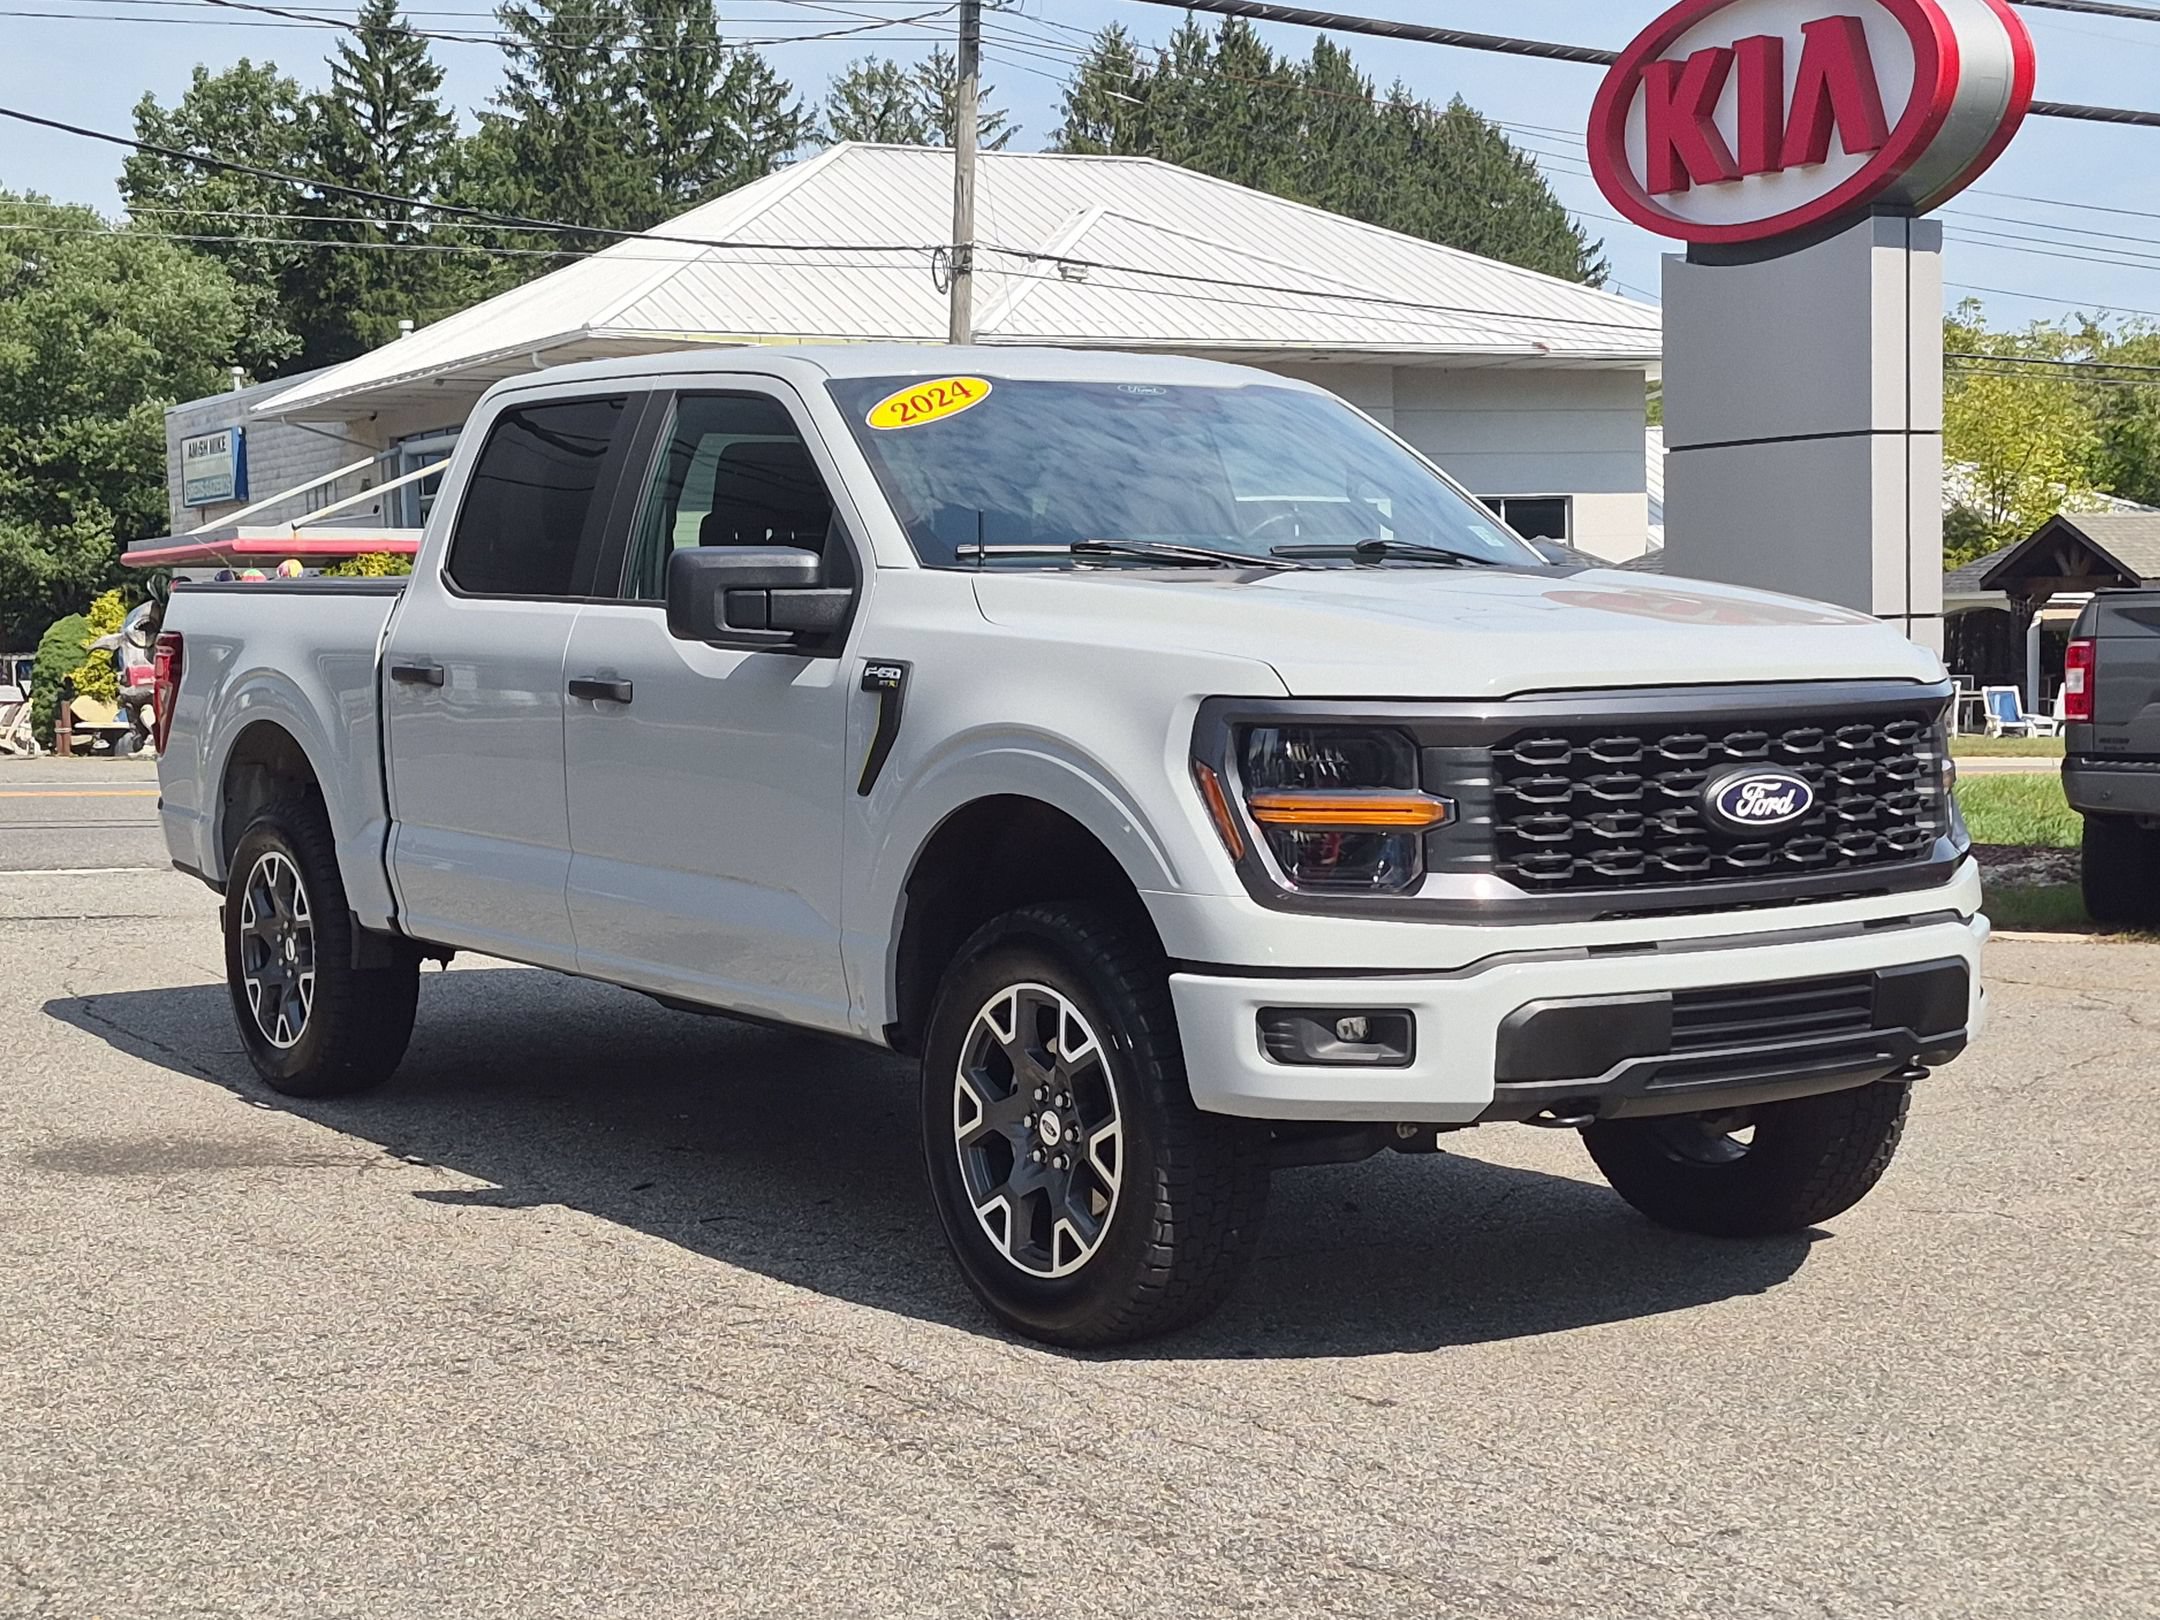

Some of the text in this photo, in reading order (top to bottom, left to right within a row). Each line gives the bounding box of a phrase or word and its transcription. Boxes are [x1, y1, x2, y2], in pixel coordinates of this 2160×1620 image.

[1639, 15, 1890, 195] KIA
[891, 381, 973, 422] 2024
[1736, 782, 1796, 817] Ford
